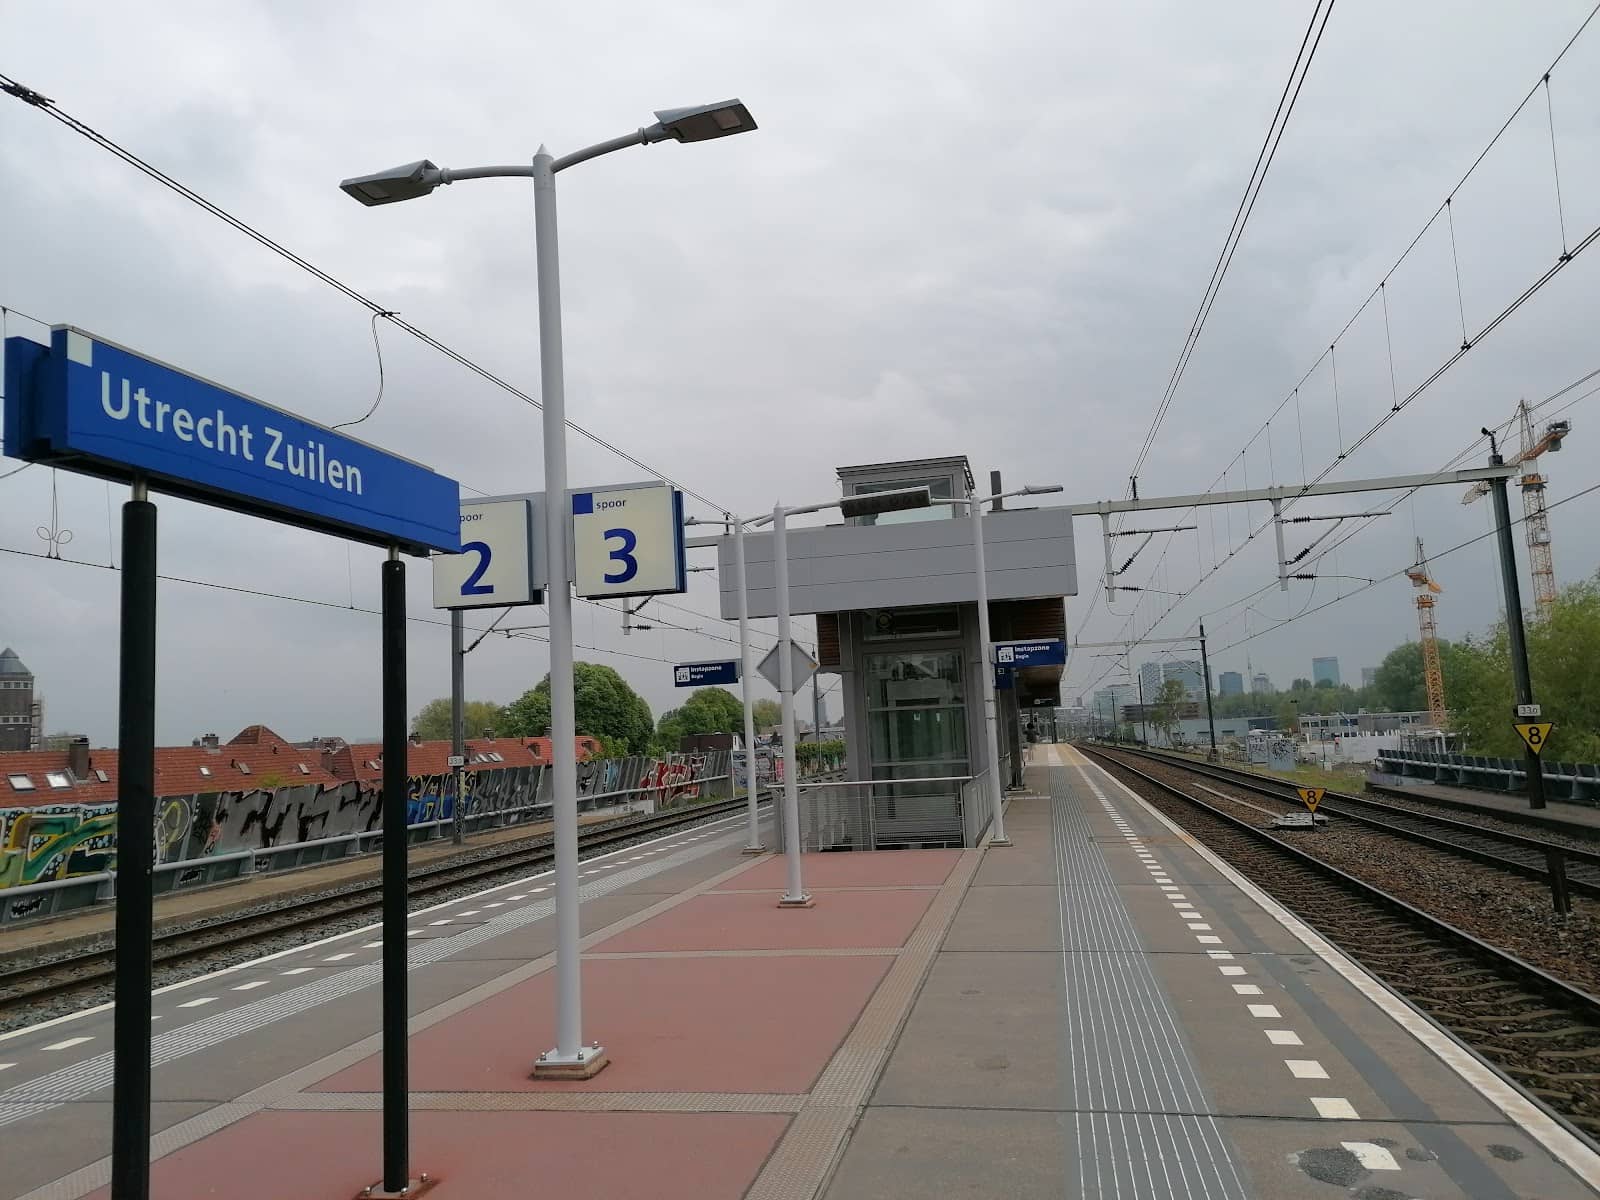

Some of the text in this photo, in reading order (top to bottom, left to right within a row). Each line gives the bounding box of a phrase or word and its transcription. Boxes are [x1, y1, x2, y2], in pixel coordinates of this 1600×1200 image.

[101, 371, 363, 496] Utrecht Zuilen
[596, 499, 627, 511] spoor
[459, 513, 483, 524] poor
[603, 528, 638, 583] 3
[460, 541, 494, 595] 2
[1529, 726, 1541, 745] 8
[1307, 790, 1317, 805] 8
